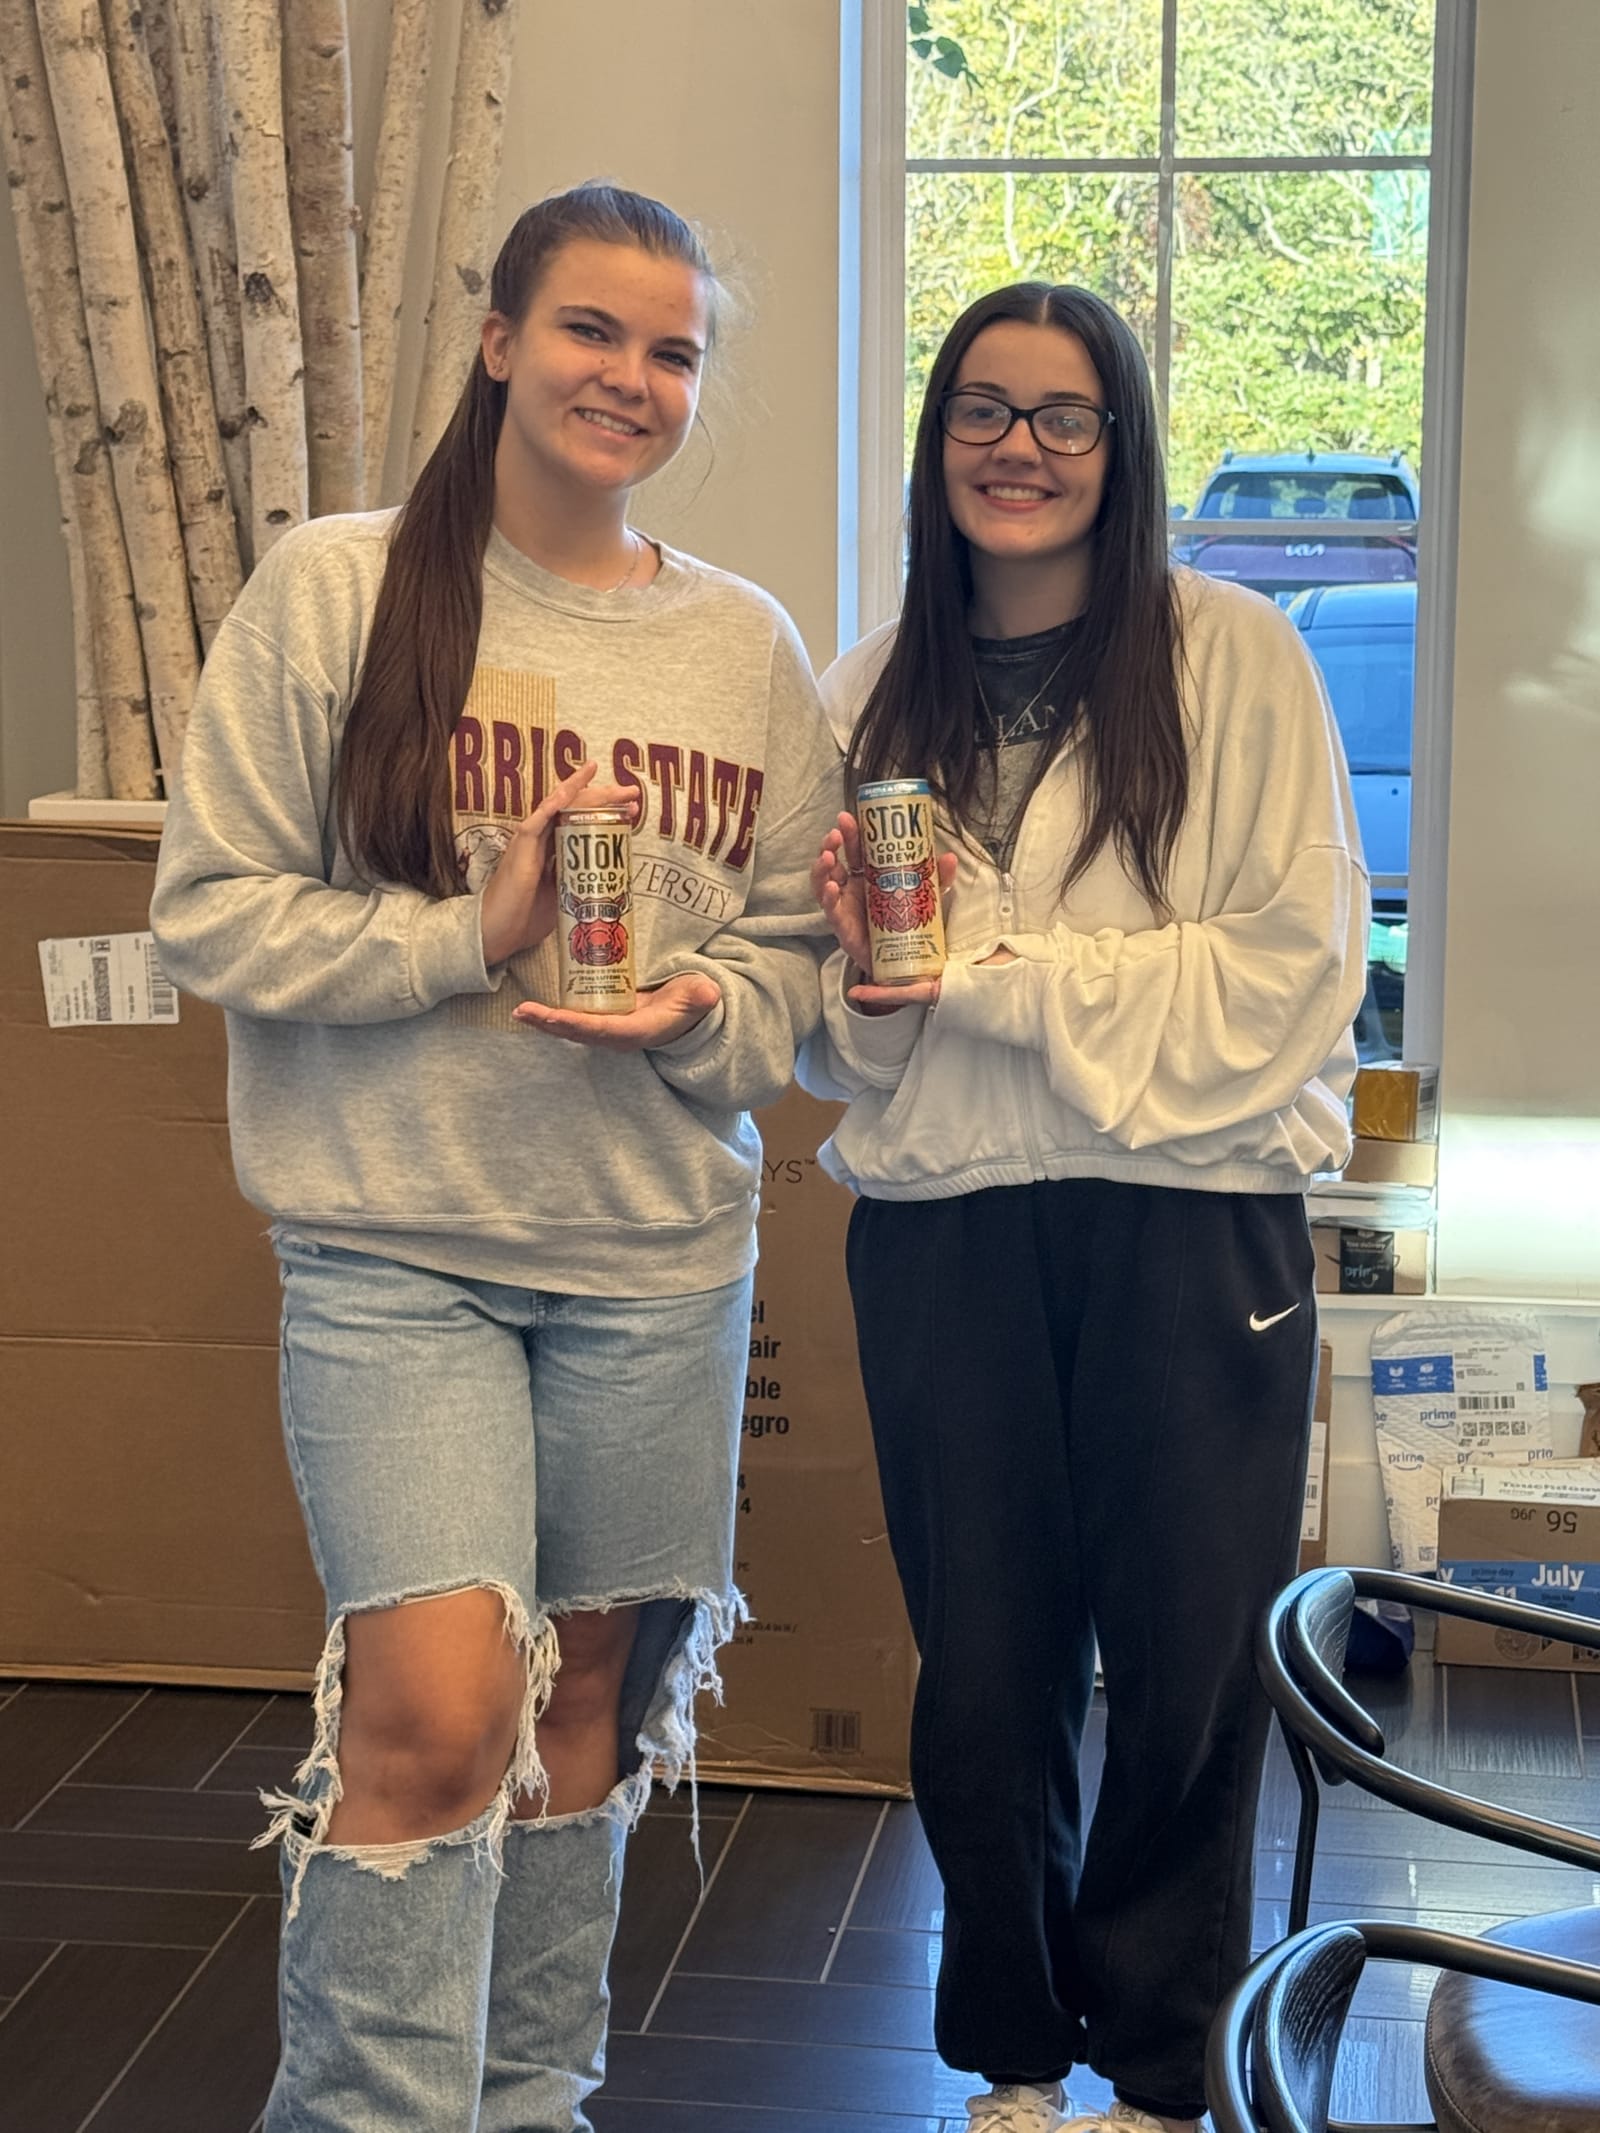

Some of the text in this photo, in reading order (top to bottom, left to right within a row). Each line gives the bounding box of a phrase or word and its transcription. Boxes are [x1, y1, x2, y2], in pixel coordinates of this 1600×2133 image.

[613, 738, 764, 873] STATE
[876, 840, 915, 854] COLD
[877, 852, 916, 865] BREW
[577, 872, 617, 883] COLD
[577, 883, 618, 894] BREW
[1420, 1408, 1456, 1422] prime
[1388, 1452, 1424, 1464] prime
[1546, 1510, 1578, 1534] 56
[1531, 1564, 1585, 1591] July
